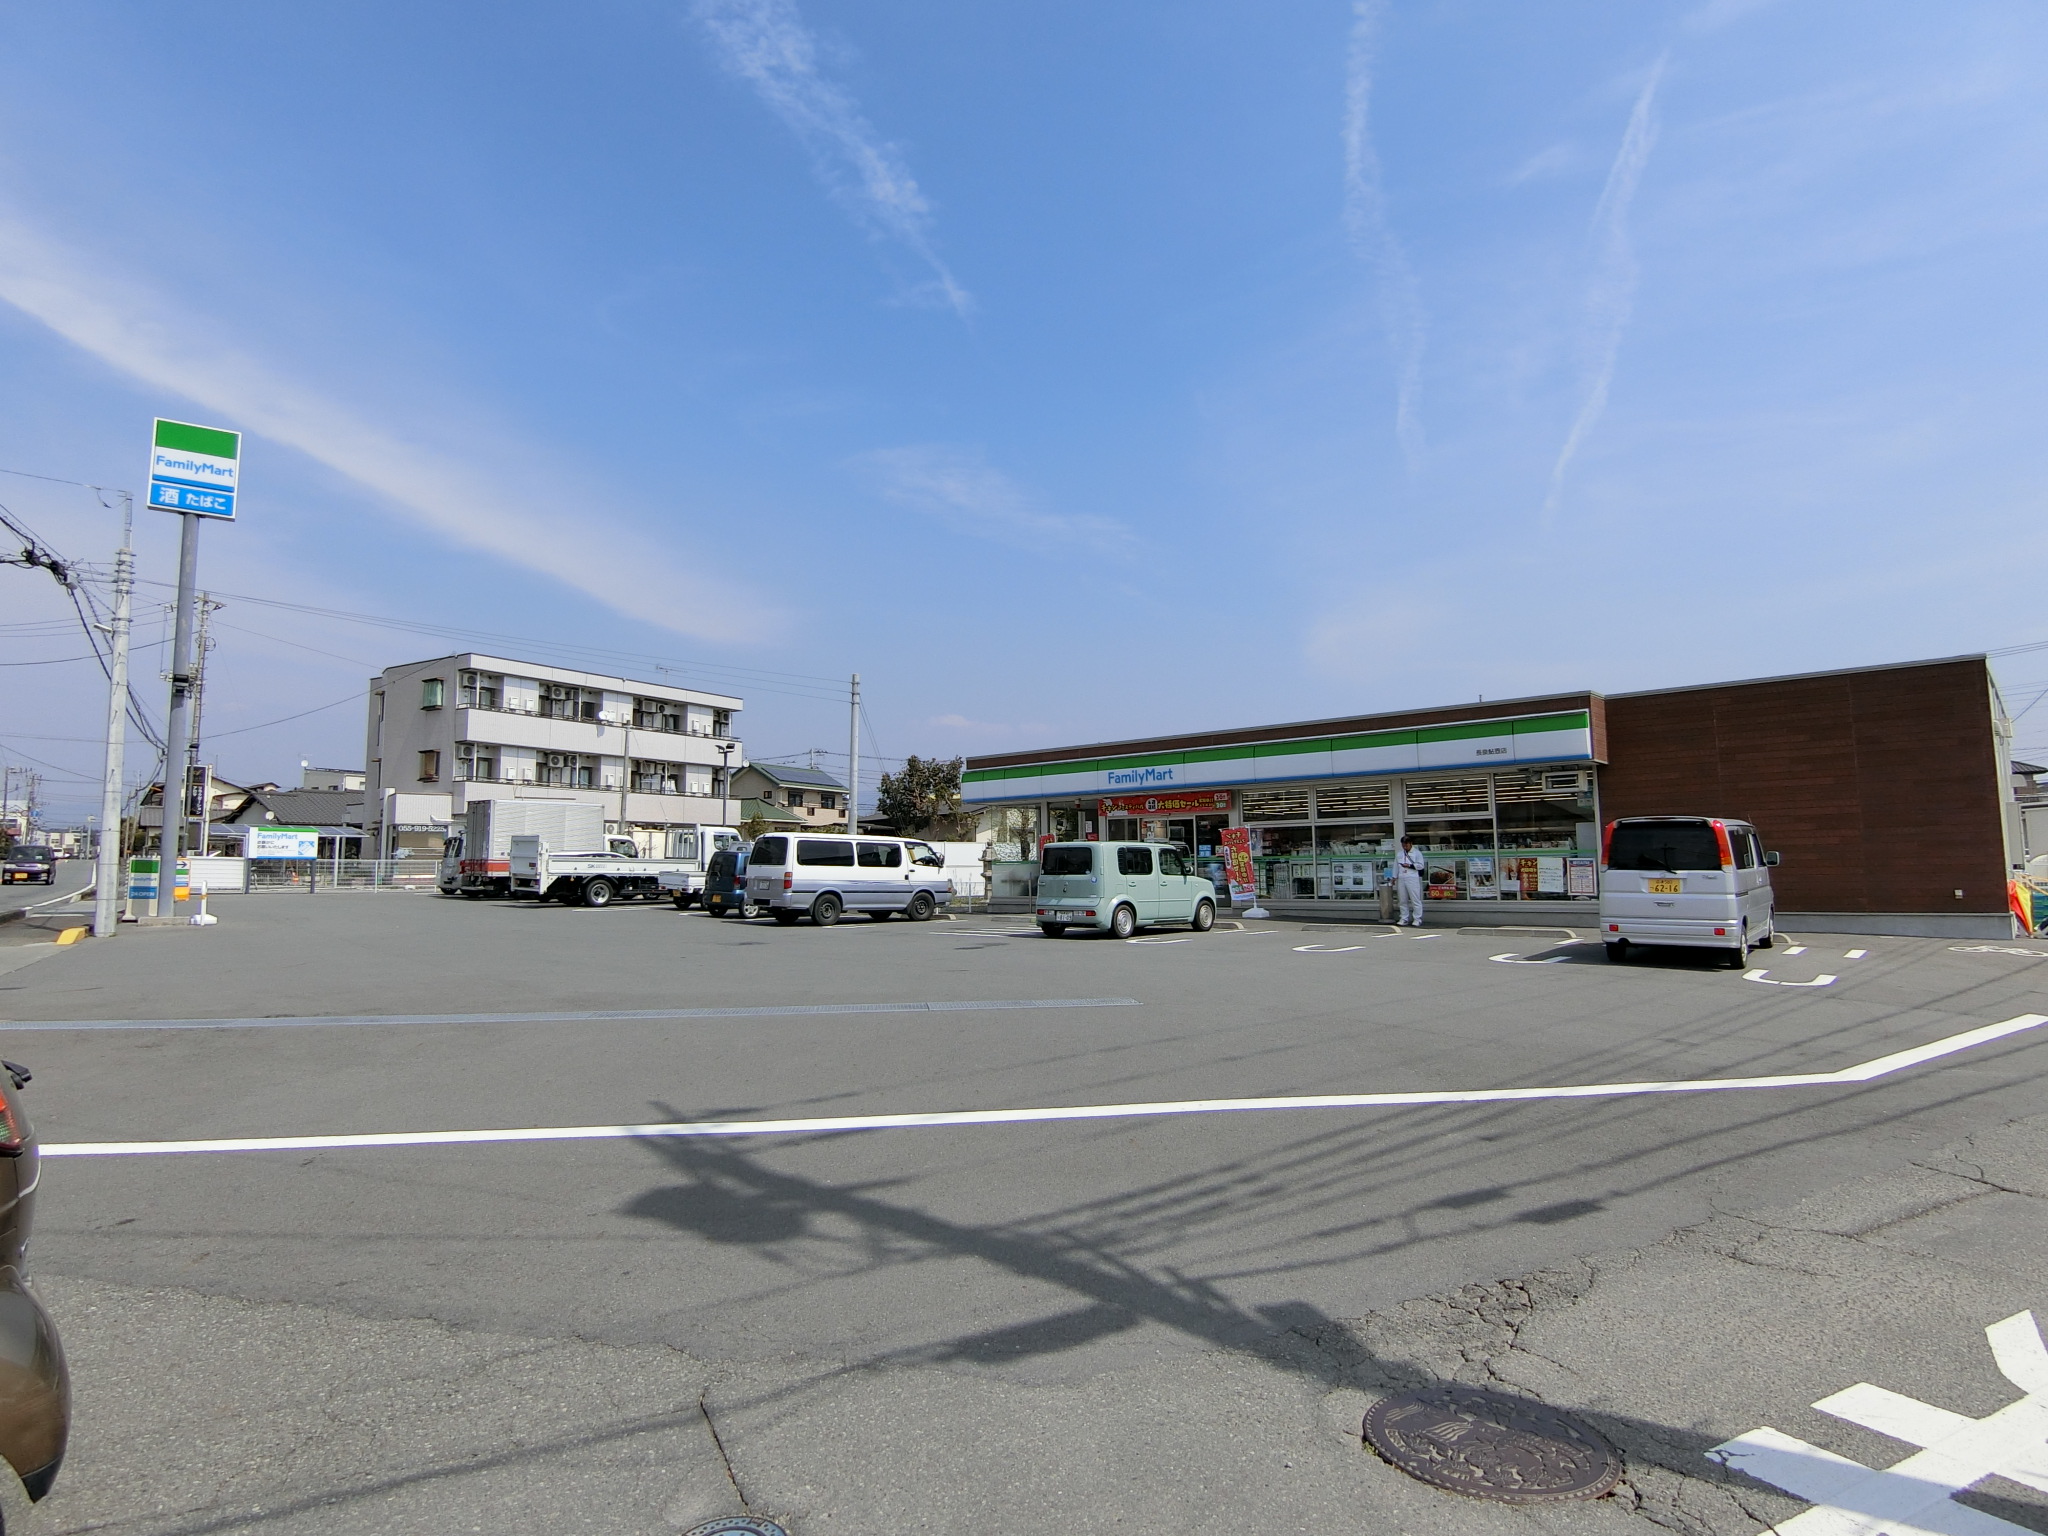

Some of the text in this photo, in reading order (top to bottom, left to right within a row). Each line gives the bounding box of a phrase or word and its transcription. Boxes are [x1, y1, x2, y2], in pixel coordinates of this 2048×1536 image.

[156, 455, 234, 477] FamilyMart
[159, 487, 226, 510] 酒 たばこ
[1107, 768, 1173, 785] FamilyMart
[257, 832, 298, 840] FamilyMart
[1654, 884, 1678, 893] 62-16
